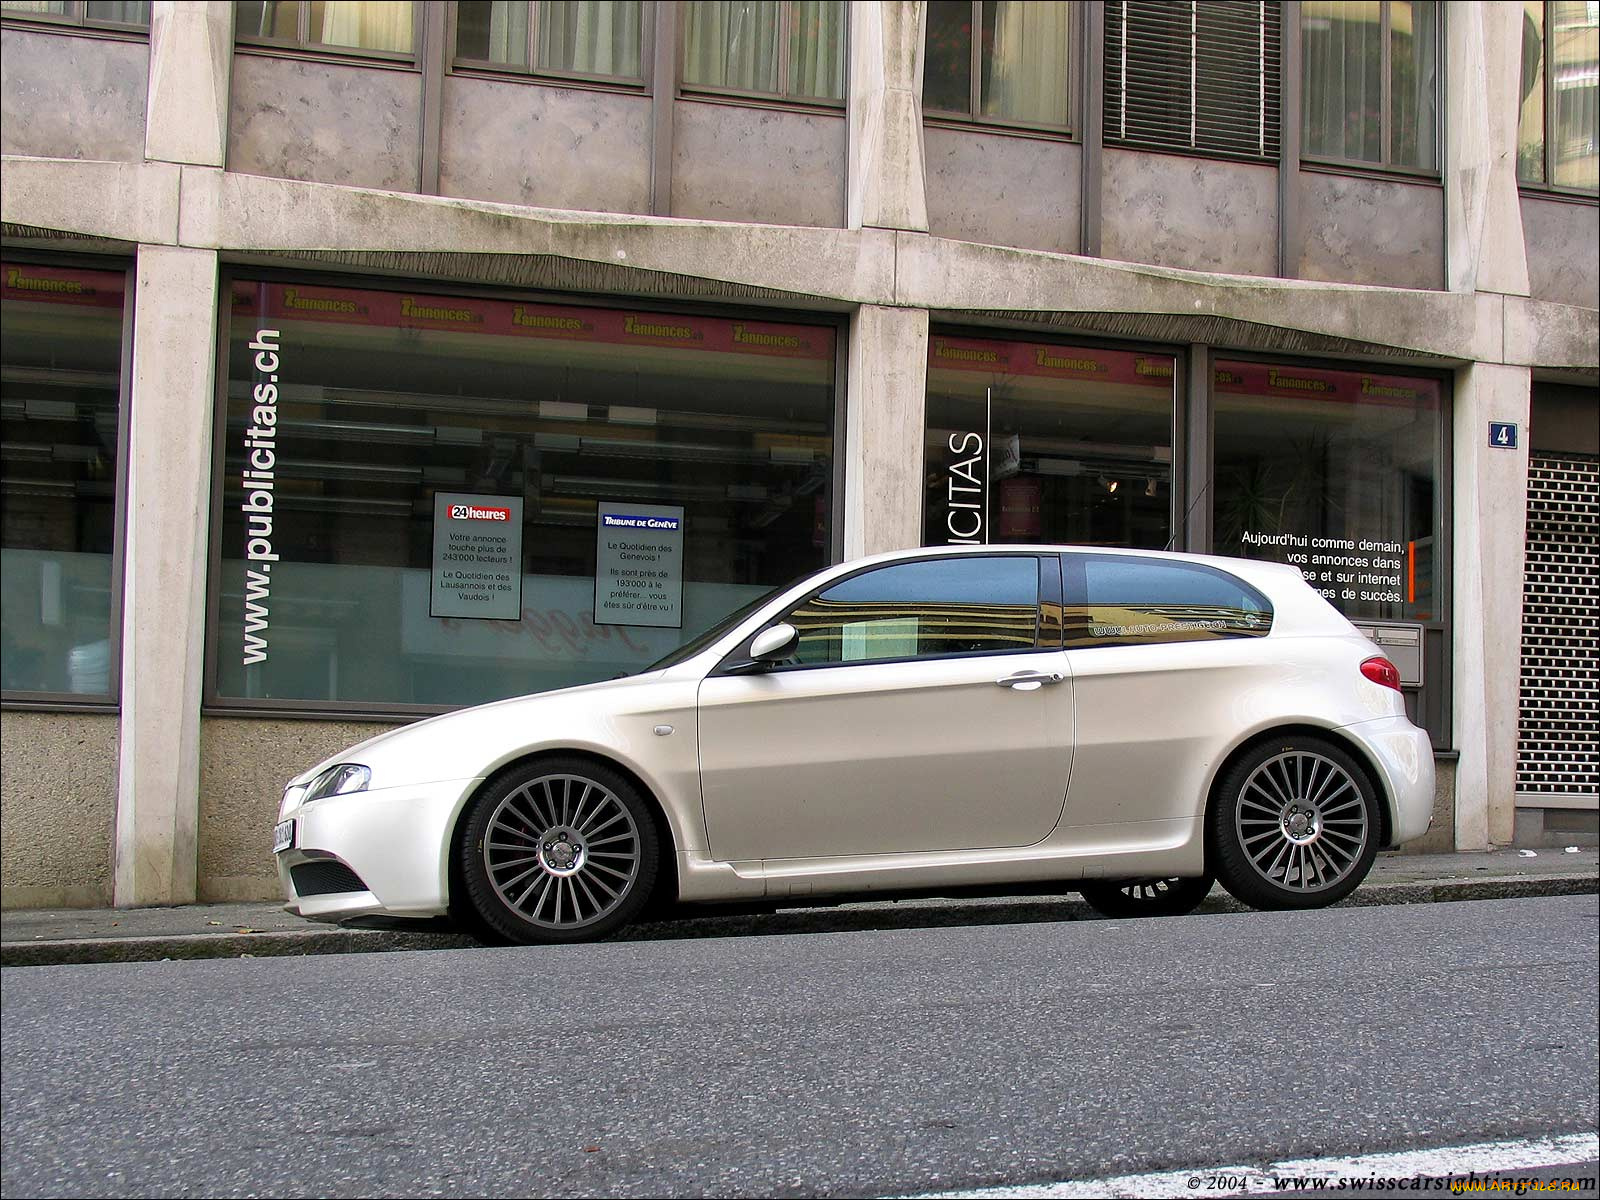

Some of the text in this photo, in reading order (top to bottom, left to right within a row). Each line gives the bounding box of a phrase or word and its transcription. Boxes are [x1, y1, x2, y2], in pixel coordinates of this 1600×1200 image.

[1497, 426, 1509, 444] 4
[242, 328, 280, 665] www.publicitas.ch
[604, 516, 636, 527] TRIBUNE
[636, 519, 646, 527] DE
[449, 533, 507, 544] Votre annonce
[1241, 531, 1405, 555] Aujourd'hui comme demain,
[448, 543, 507, 555] touche plus de
[607, 542, 672, 552] Le Quotidien des
[442, 553, 474, 562] 243'000
[476, 554, 508, 564] lecteurs
[619, 552, 656, 562] Genevois
[1287, 553, 1401, 570] vos annonces dans
[443, 570, 510, 581] Le Quotidien des
[610, 568, 668, 579] Ils sont près de
[1302, 570, 1401, 586] se et sur internet
[440, 580, 512, 592] Lausannois et des
[616, 580, 647, 588] 193'000
[655, 580, 662, 589] le
[458, 592, 490, 601] Vaudois
[648, 592, 667, 600] vous
[1341, 587, 1356, 600] de
[1360, 590, 1404, 603] succès.
[603, 600, 620, 609] êtes
[622, 601, 634, 609] sûr
[636, 601, 657, 611] d'être
[659, 603, 669, 611] vu
